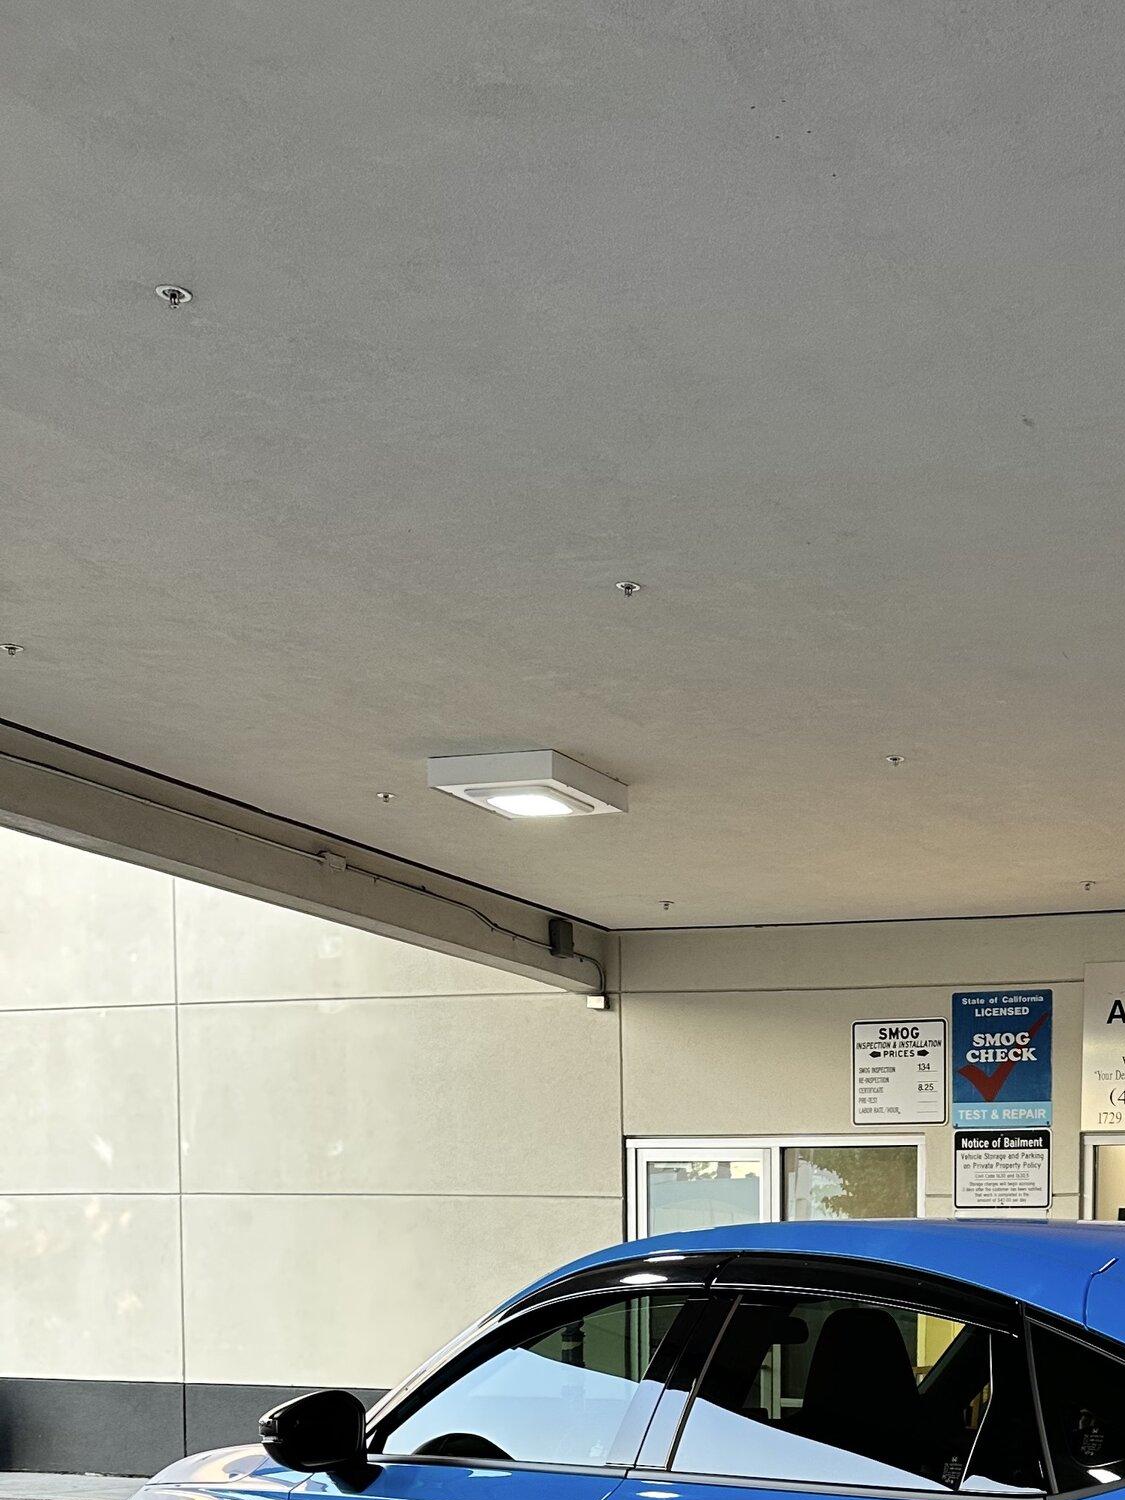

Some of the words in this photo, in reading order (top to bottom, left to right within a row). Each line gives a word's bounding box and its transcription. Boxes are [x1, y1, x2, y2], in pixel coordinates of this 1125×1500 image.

[962, 997, 985, 1005] State
[1002, 994, 1044, 1004] California
[975, 1006, 1030, 1017] LICENSED
[879, 1026, 920, 1040] SMOG
[856, 1041, 891, 1050] INSPECTION
[899, 1040, 942, 1048] INSTALLATION
[972, 1032, 1031, 1047] SMOG
[883, 1050, 915, 1058] PRICES
[966, 1047, 1037, 1063] CHECK
[958, 1109, 988, 1120] TEST
[990, 1109, 999, 1120] &
[1003, 1108, 1046, 1120] REPAIR
[1098, 1112, 1122, 1124] 1729
[961, 1137, 990, 1149] Notice
[991, 1137, 1001, 1148] of
[1003, 1136, 1043, 1148] Bailment
[961, 1152, 982, 1160] Vehicle
[983, 1152, 1007, 1161] Storage
[1007, 1152, 1019, 1160] and
[1021, 1152, 1045, 1161] Parking
[995, 1162, 1021, 1170] Property
[1023, 1162, 1041, 1170] Policy
